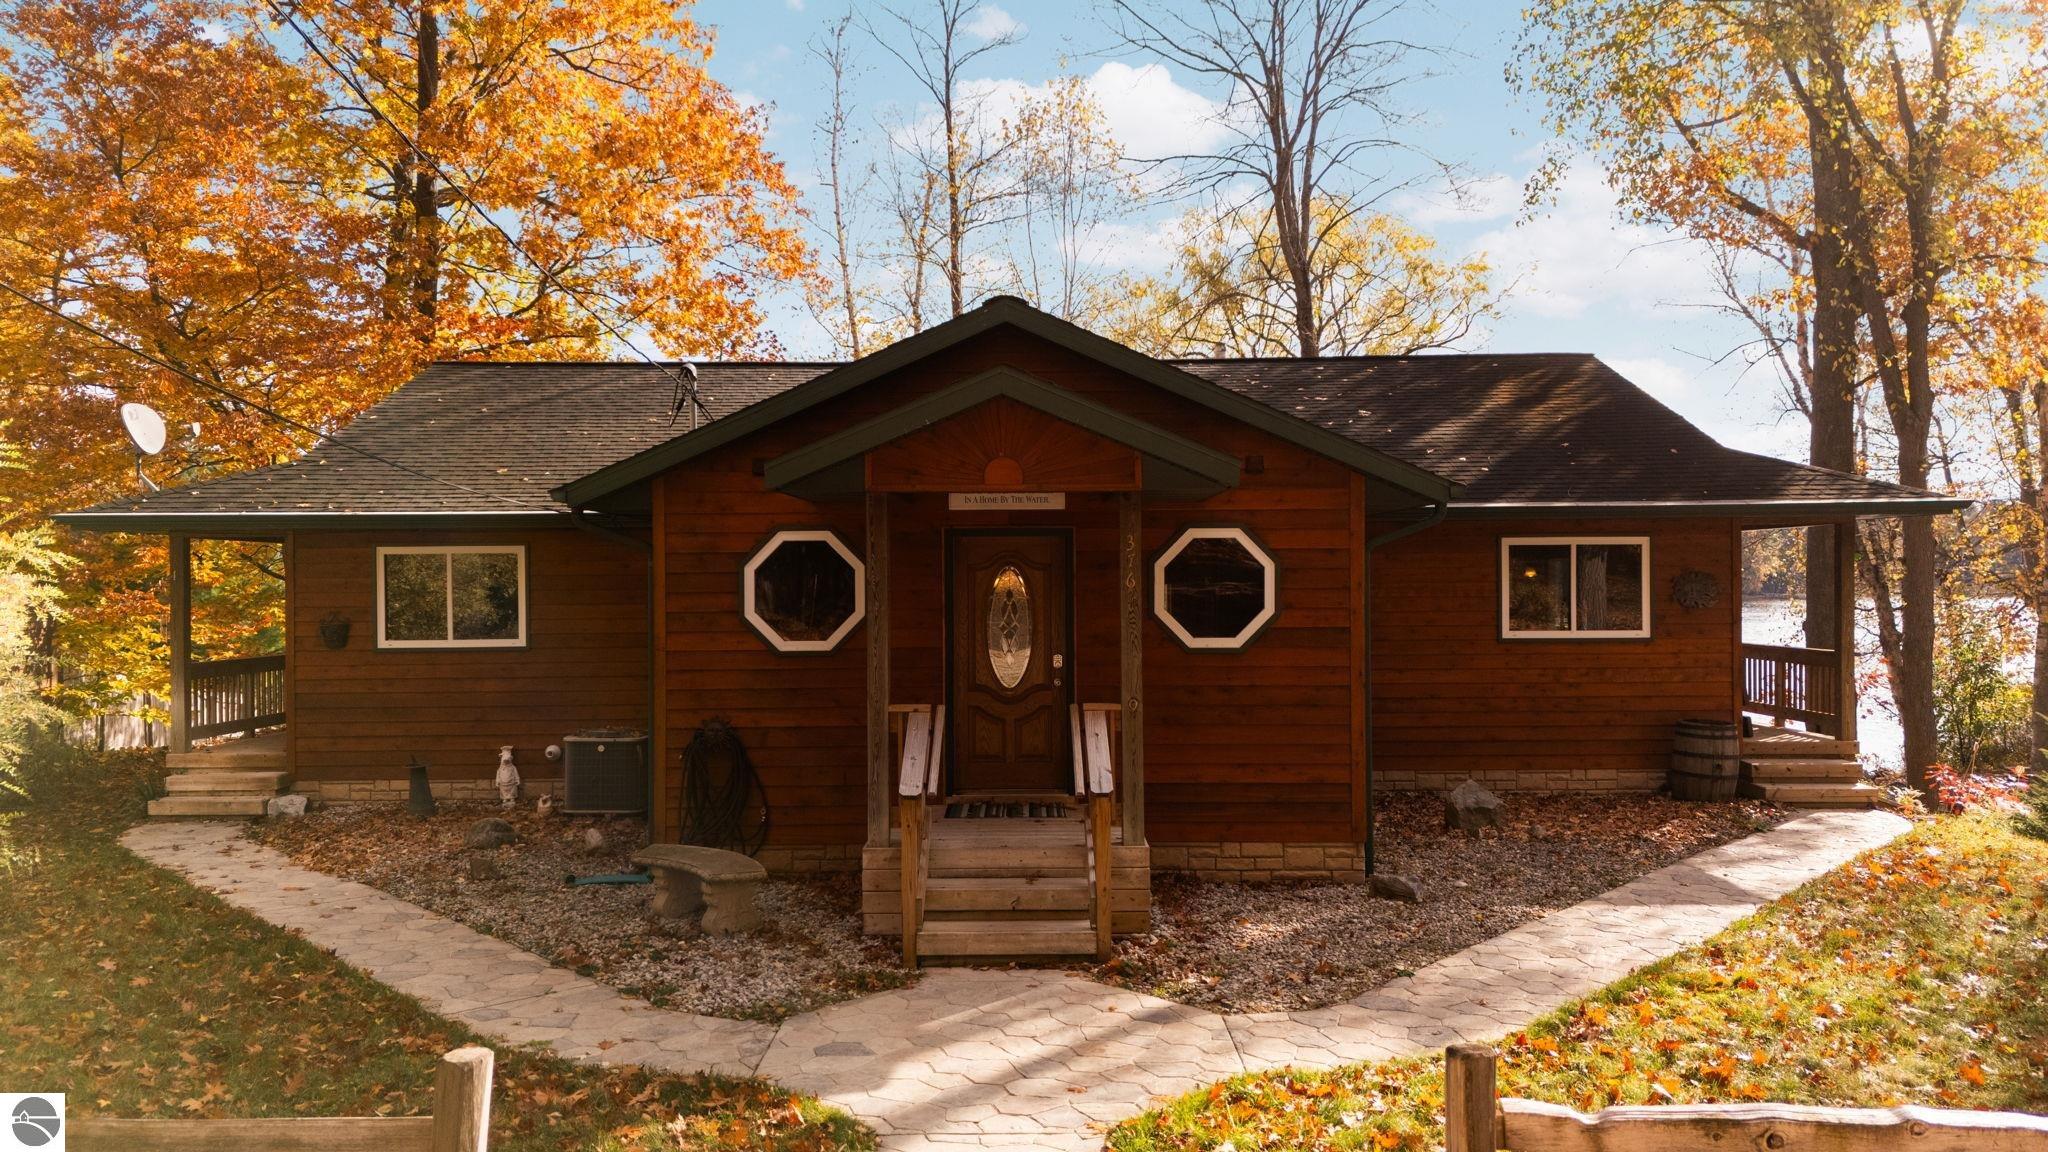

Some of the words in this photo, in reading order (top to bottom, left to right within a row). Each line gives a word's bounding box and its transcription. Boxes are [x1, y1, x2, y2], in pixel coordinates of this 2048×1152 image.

[964, 495, 972, 504] IN
[979, 495, 998, 504] HOME
[1001, 495, 1010, 504] BY
[1011, 495, 1025, 504] THE
